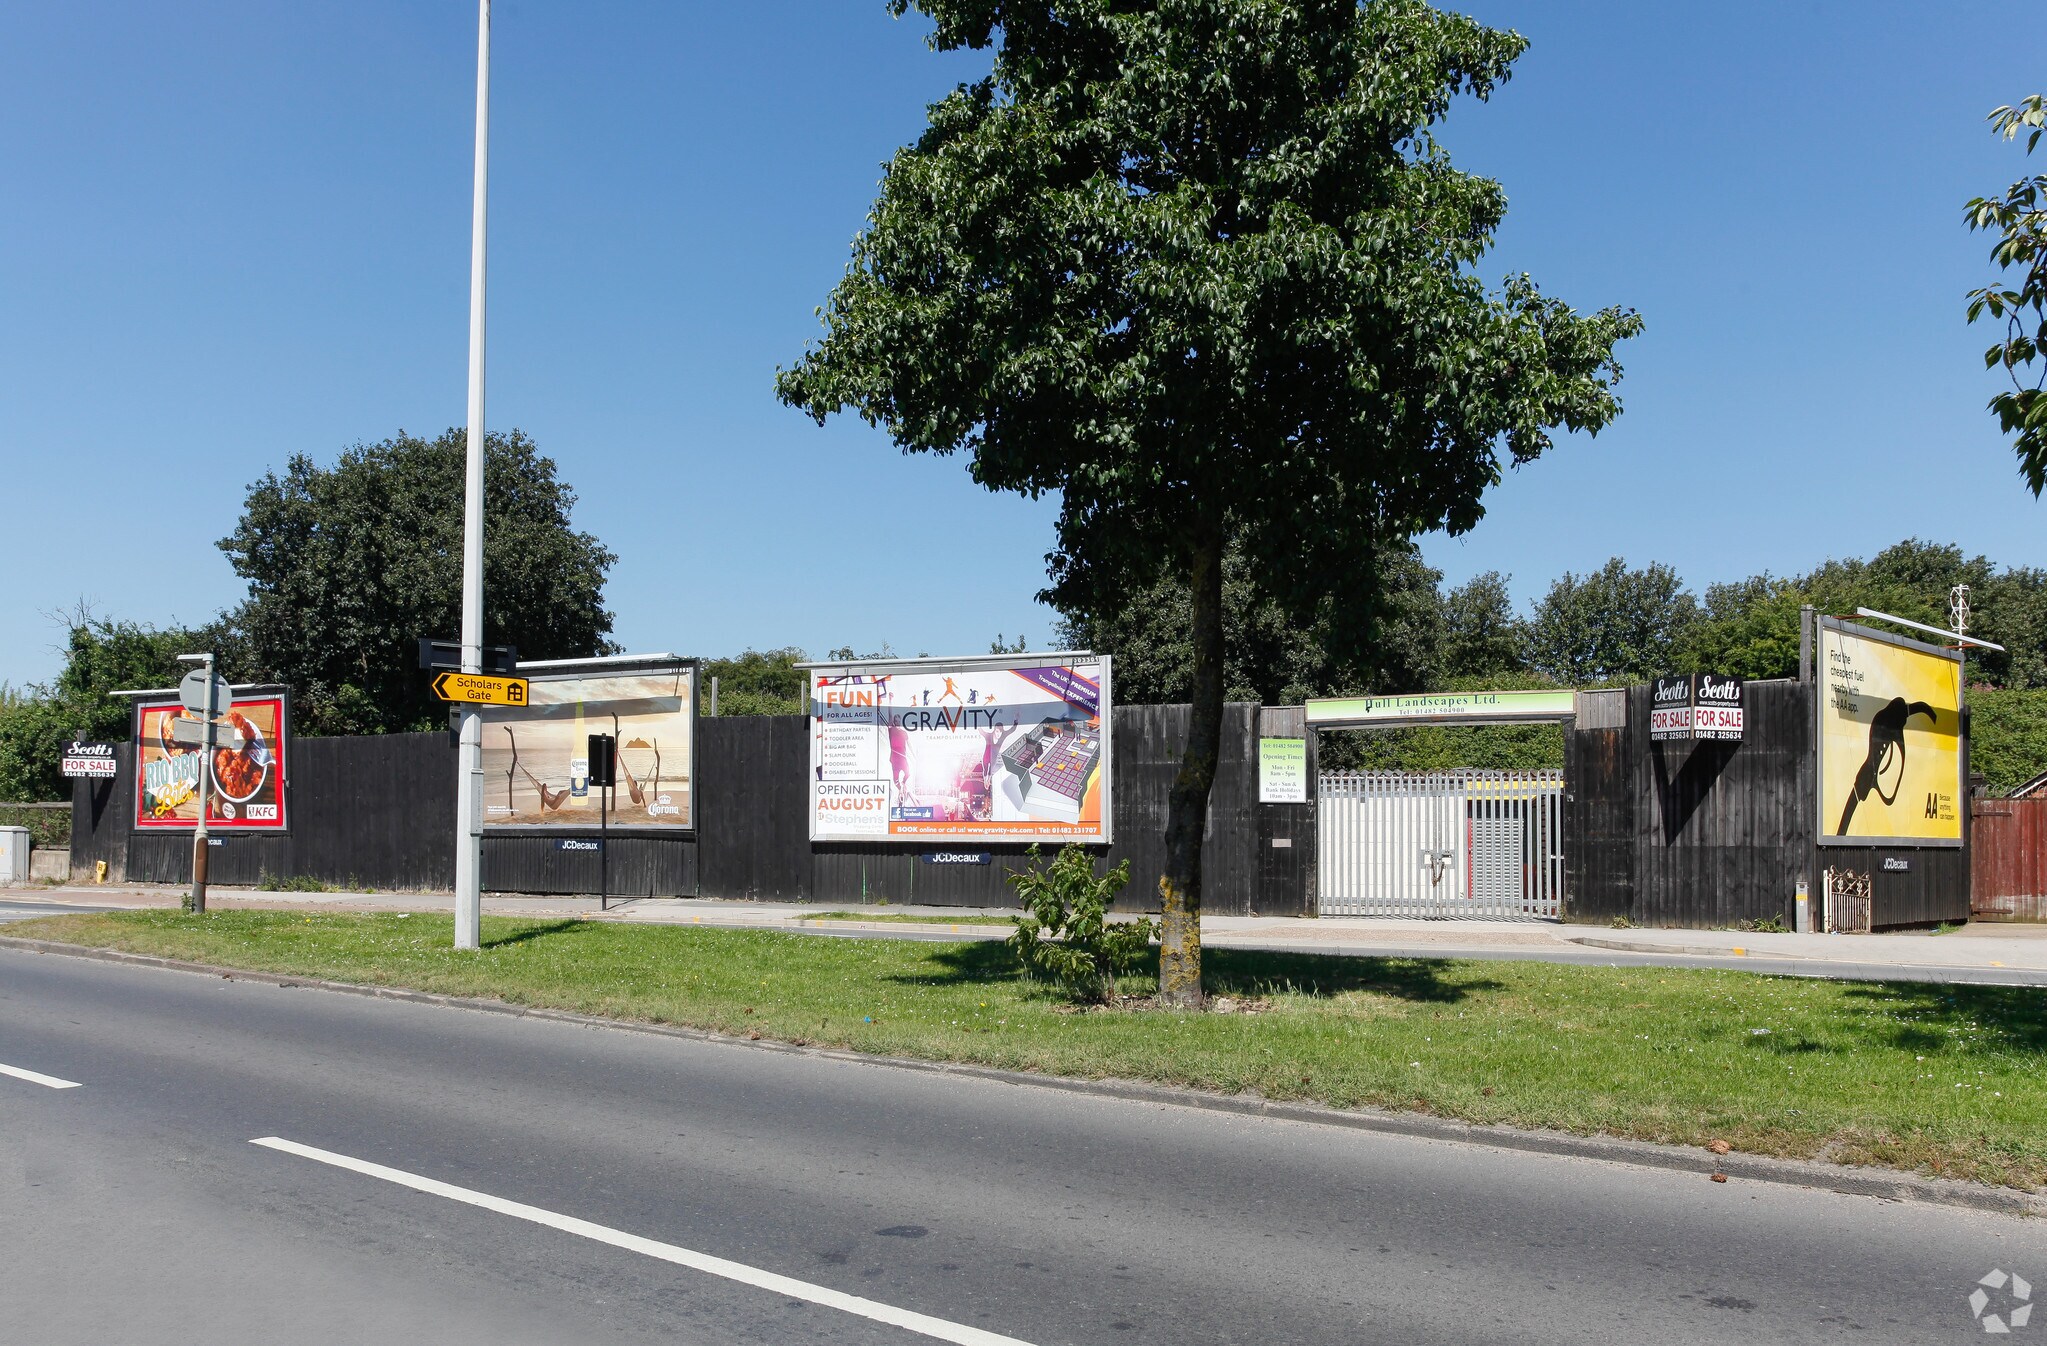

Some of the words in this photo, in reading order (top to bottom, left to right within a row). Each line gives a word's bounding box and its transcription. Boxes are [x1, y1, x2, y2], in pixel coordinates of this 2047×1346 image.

[1831, 650, 1842, 662] Find
[1842, 652, 1851, 664] the
[1831, 666, 1854, 680] cheapest
[1855, 670, 1865, 682] fuel
[457, 678, 502, 690] Scholars
[1052, 670, 1060, 679] The
[1071, 681, 1097, 698] PREMIUM
[1654, 679, 1689, 702] Scotts
[1699, 675, 1740, 700] Scotts
[1831, 683, 1848, 697] nearby
[467, 690, 491, 700] Gate
[1038, 674, 1066, 694] Trampolining
[1066, 690, 1099, 711] EXPERIENCE
[827, 691, 873, 709] FUN
[1396, 696, 1468, 708] Landscapes
[1474, 695, 1500, 705] Ltd.
[1831, 698, 1839, 709] the
[1840, 699, 1848, 711] AA
[902, 705, 998, 734] GRAVITY
[1652, 713, 1667, 729] FOR
[1669, 711, 1690, 728] SALE
[1696, 710, 1716, 726] FOR
[1719, 711, 1741, 728] SALE
[1669, 731, 1689, 740] 325634
[1696, 731, 1716, 739] 01482
[1718, 732, 1742, 740] 325634
[68, 741, 113, 756] Scotts
[65, 760, 86, 770] FOR
[89, 760, 115, 771] SALE
[146, 759, 170, 790] RIO
[172, 750, 199, 784] BBQ
[818, 785, 870, 795] OPENING
[873, 785, 885, 794] IN
[155, 780, 195, 816] Bites
[818, 798, 885, 811] AUGUST
[255, 806, 275, 817] KFC
[648, 802, 680, 817] Corona
[1925, 792, 1937, 819] AA
[825, 813, 884, 825] Stephen's
[967, 827, 1034, 835] www.gravity-uk.com
[562, 840, 598, 850] JCDecaux
[932, 852, 980, 863] JCDecaux
[1883, 857, 1909, 870] JCDecaux
